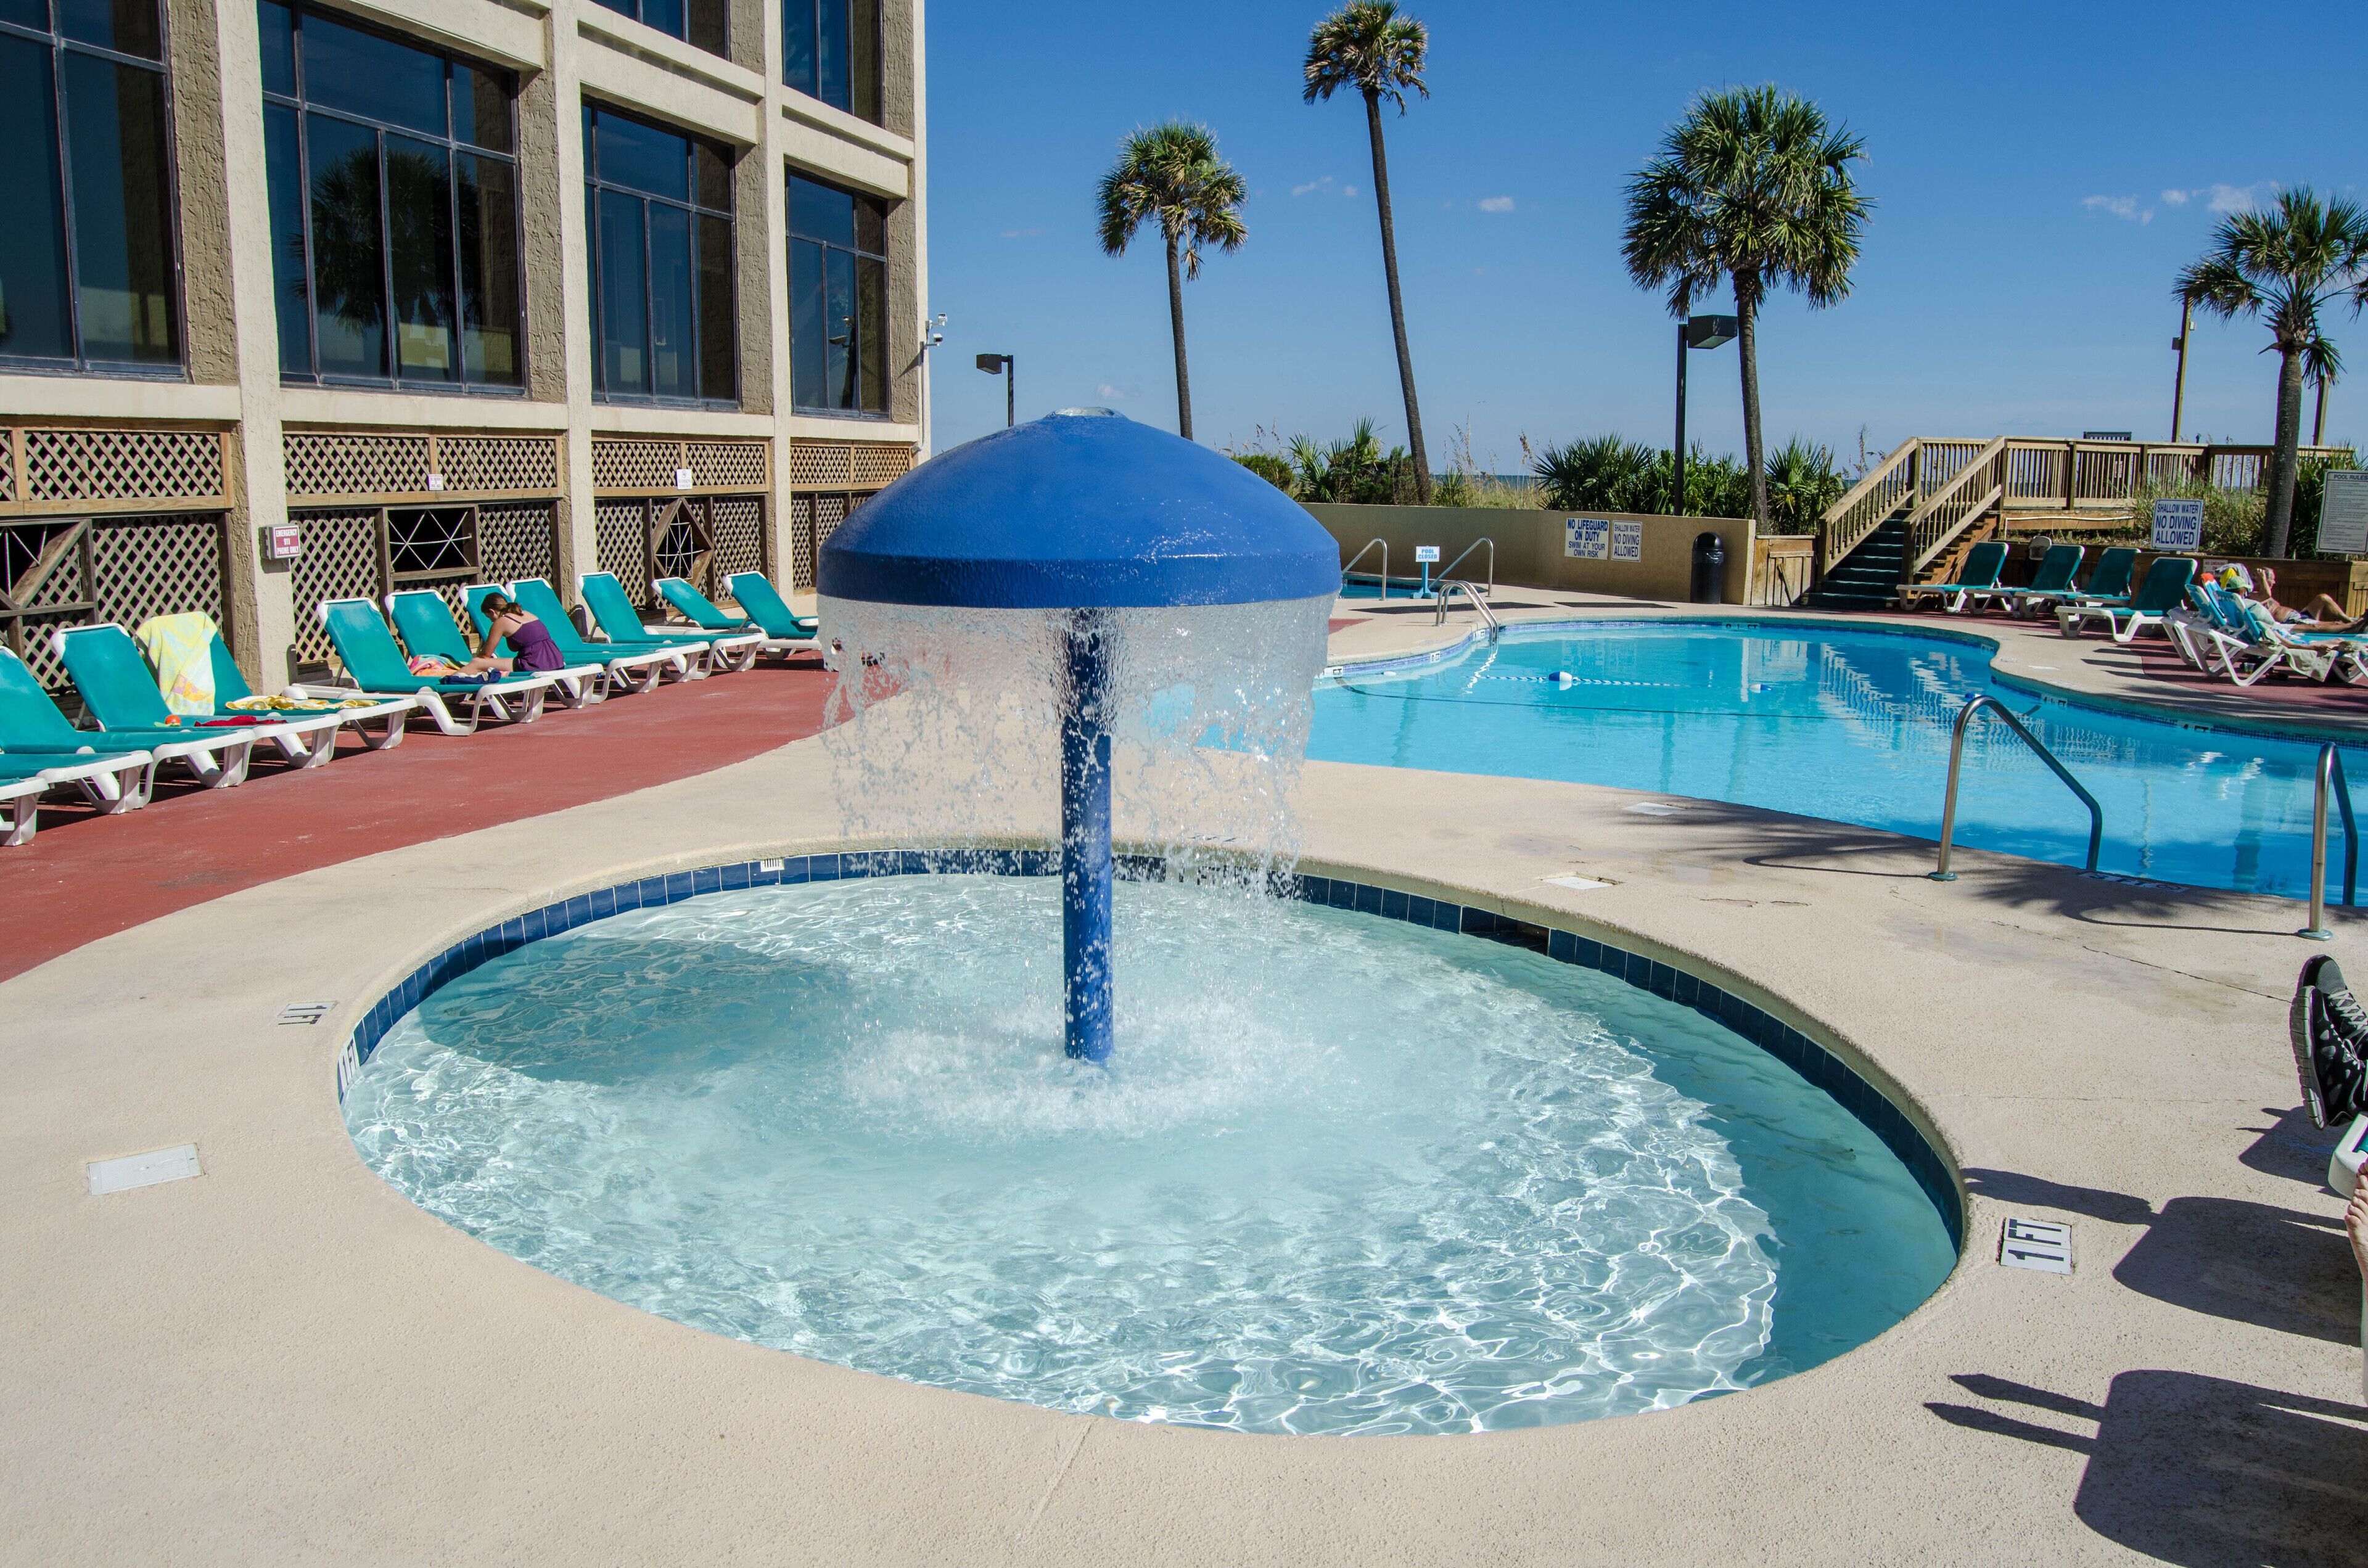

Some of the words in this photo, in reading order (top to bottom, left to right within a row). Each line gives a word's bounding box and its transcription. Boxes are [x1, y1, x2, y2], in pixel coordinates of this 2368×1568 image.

[2157, 504, 2180, 513] SHALLOW
[2182, 504, 2198, 514] WATER
[1568, 519, 1575, 529] NO
[1578, 519, 1608, 532] LIFEGUARD
[1614, 524, 1628, 532] SHALLOW
[2156, 515, 2167, 528] NO
[2169, 515, 2197, 530] DIVING
[1575, 530, 1582, 541] ON
[1585, 531, 1600, 542] DUTY
[1614, 533, 1621, 544] NO
[1622, 534, 1639, 545] DIVING
[2155, 530, 2194, 545] ALLOWED
[1574, 549, 1585, 557] OWN
[1592, 543, 1605, 551] YOUR
[1614, 545, 1638, 557] ALLOWED
[278, 1014, 322, 1025] FT
[2008, 1218, 2062, 1246] FT
[2008, 1249, 2064, 1262] 1
